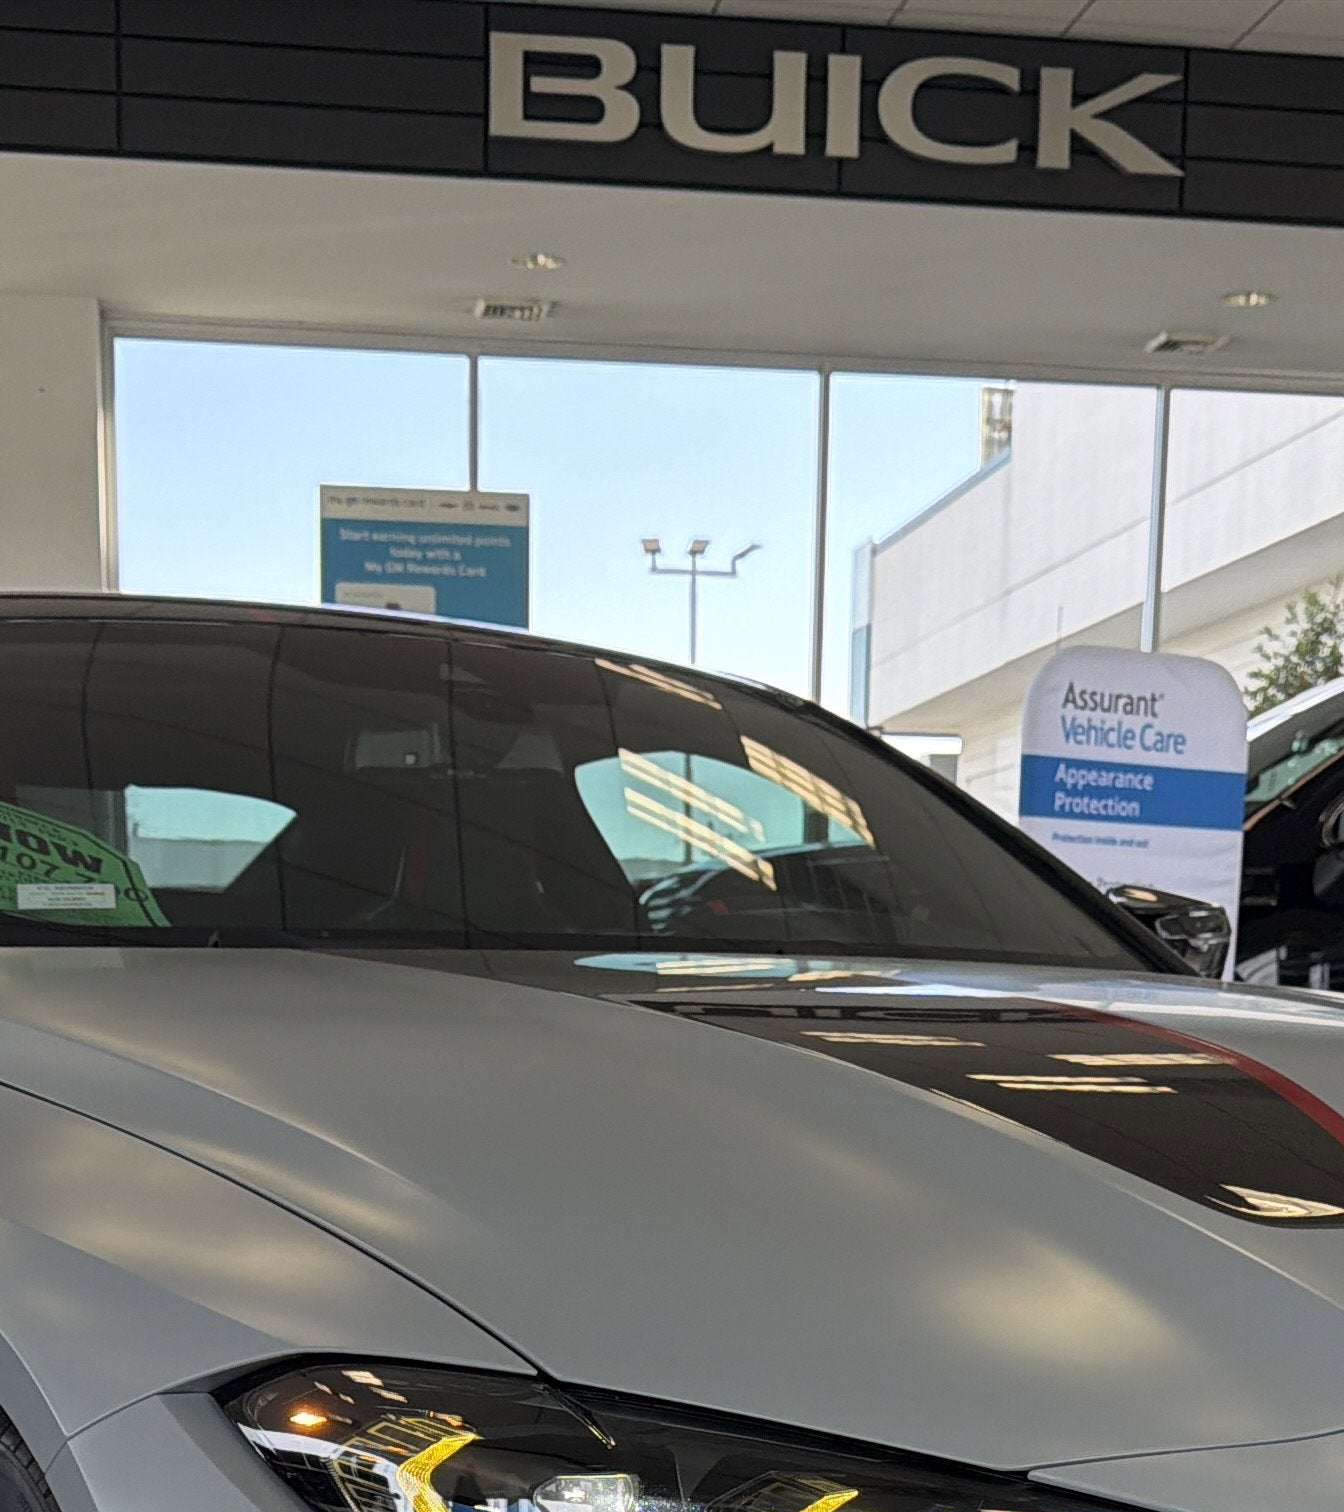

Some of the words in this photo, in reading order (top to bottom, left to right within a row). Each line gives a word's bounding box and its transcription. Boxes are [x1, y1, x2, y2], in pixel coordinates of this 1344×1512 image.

[487, 29, 1185, 178] BUICK
[1061, 715, 1137, 750] Vehicle
[1139, 723, 1187, 755] Care
[1054, 763, 1154, 791] Appearance
[1054, 791, 1140, 817] Protection
